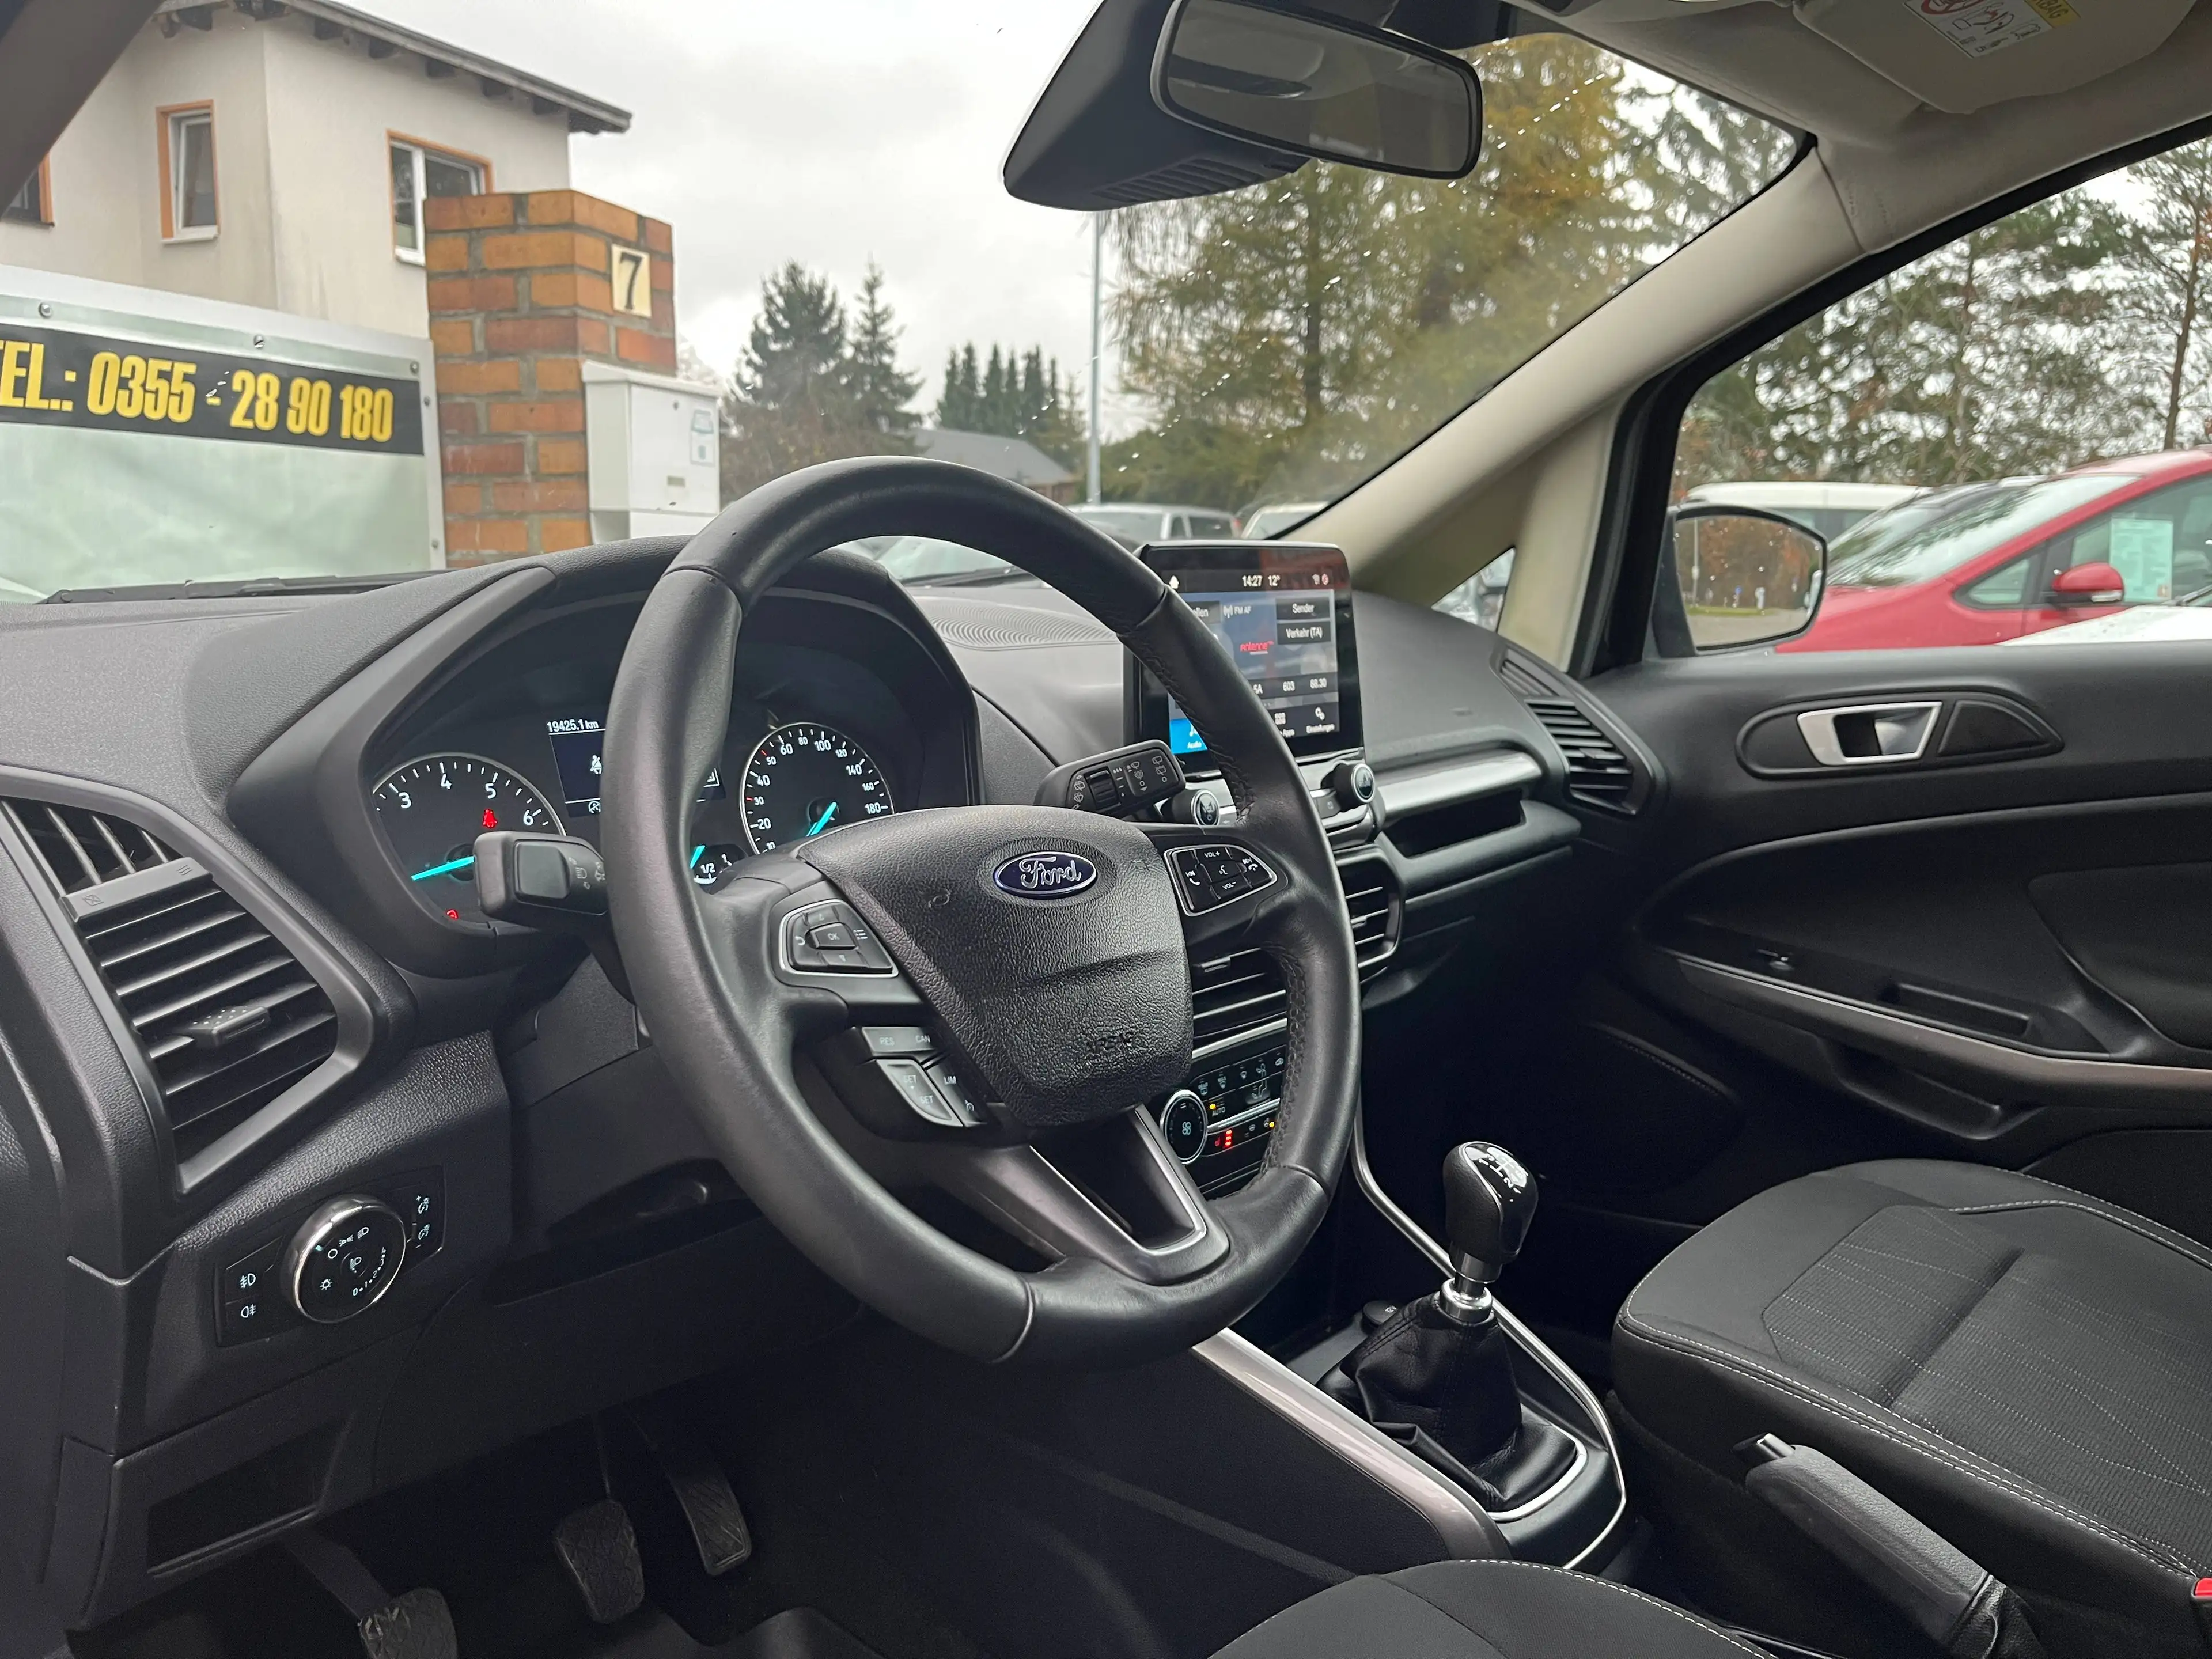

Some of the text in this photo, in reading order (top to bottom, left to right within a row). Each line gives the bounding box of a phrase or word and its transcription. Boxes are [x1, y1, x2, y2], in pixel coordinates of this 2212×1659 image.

[2032, 0, 2069, 18] BAG
[618, 252, 642, 309] 7
[0, 339, 77, 412] EL.:
[87, 351, 196, 423] 0355
[229, 370, 280, 431] 28
[286, 376, 331, 438] 90
[340, 384, 394, 443] 180
[1242, 574, 1281, 586] 14:27 12°
[1192, 607, 1209, 618] ellen
[1234, 606, 1251, 615] FM AF
[1292, 603, 1315, 613] Sender
[1286, 627, 1323, 639] Verkehr (TA)
[1282, 681, 1296, 692] 603
[546, 719, 599, 733] 19425.1 km
[798, 736, 808, 746] 80
[814, 740, 831, 752] 100
[1187, 741, 1202, 749] Audio
[780, 743, 794, 755] 60
[835, 748, 848, 758] 120
[766, 756, 777, 766] 50
[846, 764, 863, 775] 140
[441, 774, 452, 790] 4
[757, 774, 770, 786] 40
[485, 782, 496, 798] 5
[862, 782, 875, 791] 160
[399, 792, 412, 809] 3
[754, 797, 764, 806] 30
[865, 802, 881, 814] 180
[523, 809, 534, 825] 6
[757, 819, 772, 830] 20
[766, 841, 775, 851] 10
[700, 863, 716, 874] 1/2
[1018, 855, 1081, 889] Ford
[828, 932, 840, 941] OK
[880, 1035, 931, 1046] RES CAN
[903, 1074, 917, 1084] SET
[944, 1075, 957, 1085] LIM
[921, 1094, 934, 1104] SET
[1212, 1106, 1226, 1117] AUTO
[1503, 1177, 1514, 1188] 2
[373, 1270, 377, 1279] 2
